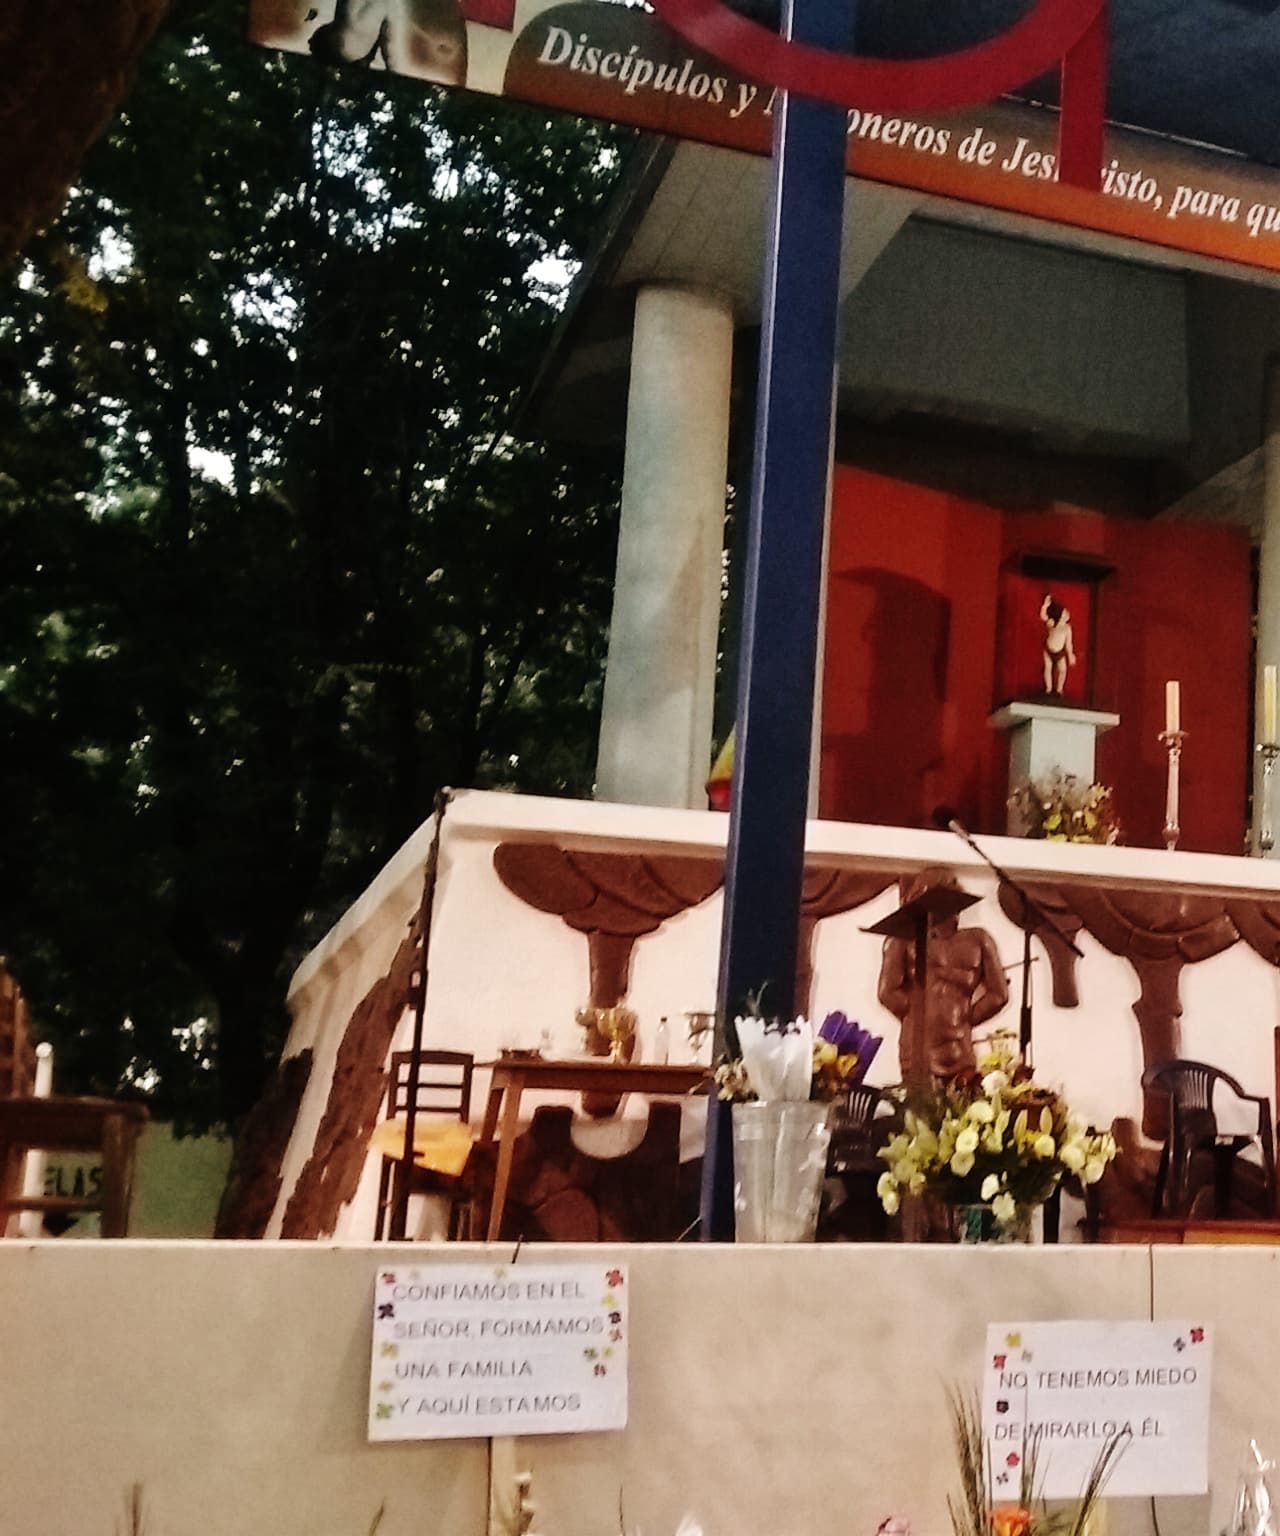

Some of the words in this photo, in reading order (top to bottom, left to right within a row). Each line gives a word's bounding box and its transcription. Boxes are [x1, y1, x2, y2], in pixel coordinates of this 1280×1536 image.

[538, 25, 727, 104] Discípulos
[729, 82, 757, 118] y
[957, 128, 997, 166] de
[1168, 185, 1241, 221] para
[392, 1282, 520, 1300] CONFIAMOS
[527, 1282, 554, 1299] EN
[562, 1281, 585, 1298] EL
[480, 1317, 604, 1337] FORMAMOS
[394, 1362, 440, 1380] UNA
[448, 1359, 533, 1377] FAMILIA
[1000, 1371, 1028, 1389] NO
[1036, 1369, 1129, 1389] TENEMOS
[1135, 1367, 1198, 1386] MIEDO
[399, 1399, 412, 1415] Y
[417, 1395, 470, 1416] AQUÍ
[476, 1394, 581, 1415] ESTAMOS
[994, 1423, 1020, 1441] DE
[1026, 1420, 1117, 1440] MIRARLO
[1118, 1420, 1133, 1435] A
[1142, 1417, 1164, 1436] ÉL
